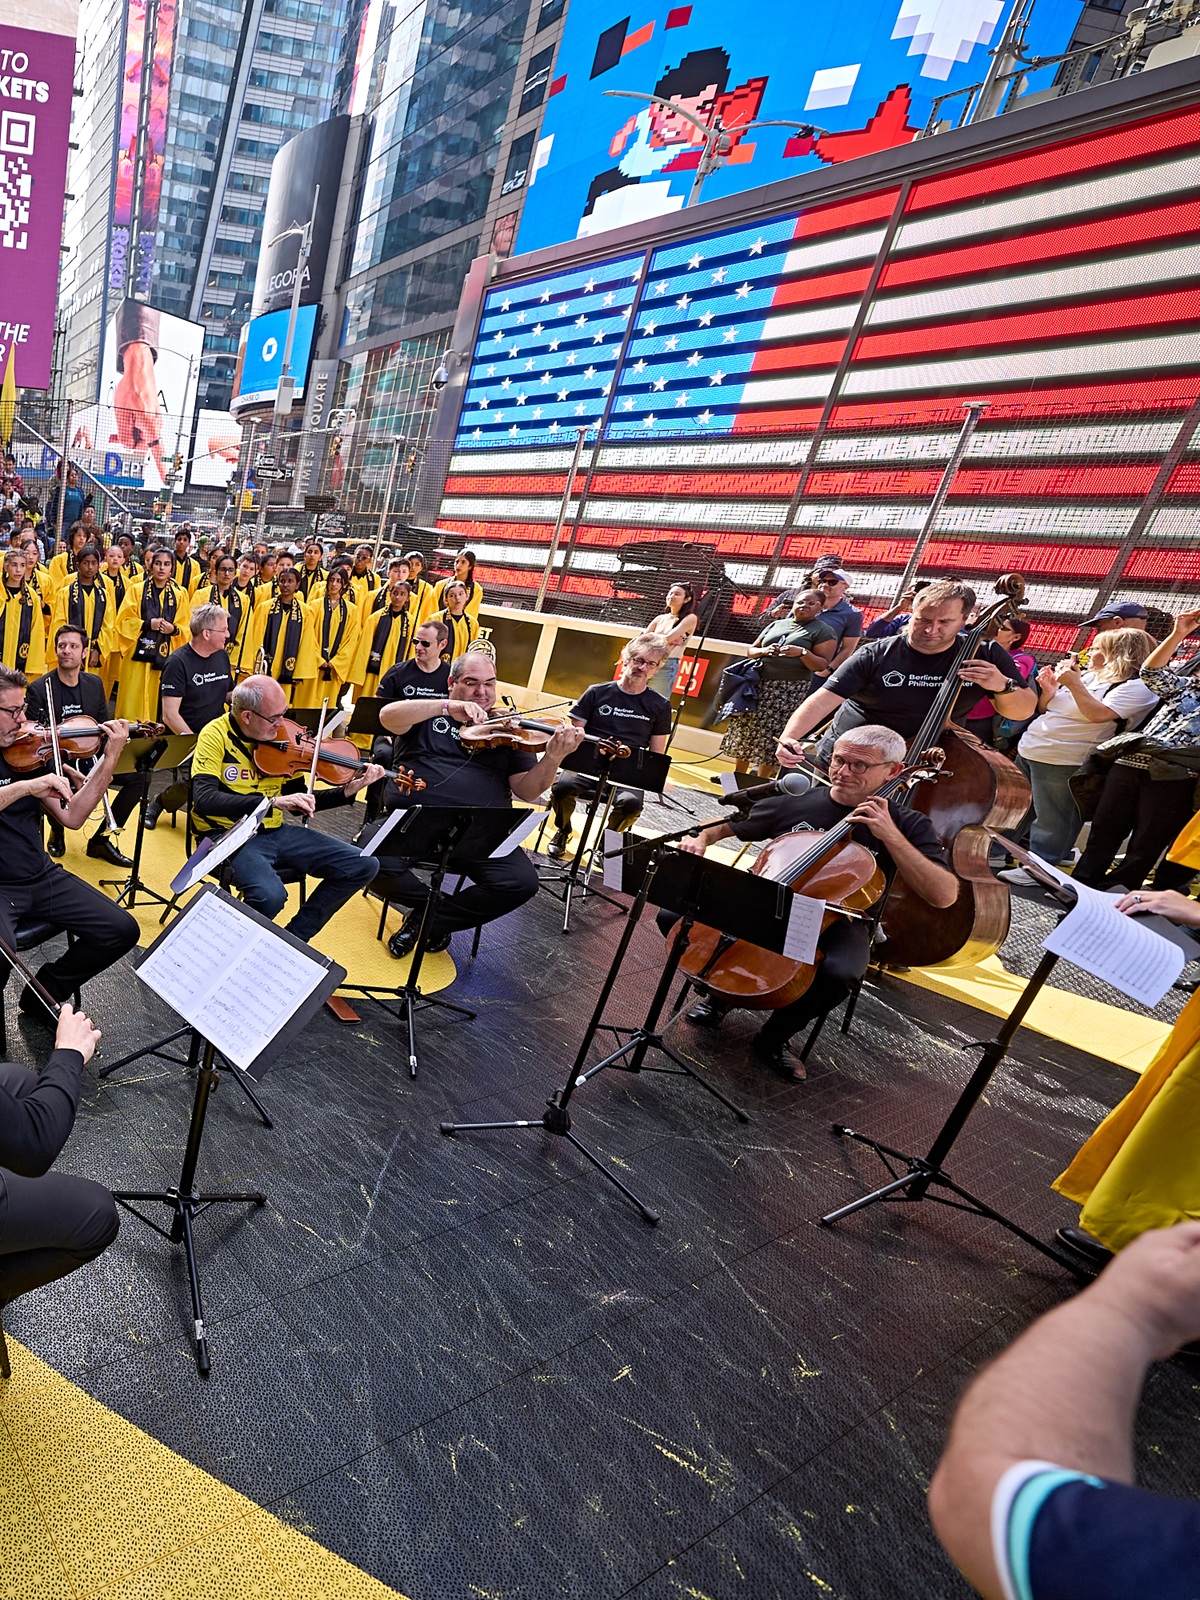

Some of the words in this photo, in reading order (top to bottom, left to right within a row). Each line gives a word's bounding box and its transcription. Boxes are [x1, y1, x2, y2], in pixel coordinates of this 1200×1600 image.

[1, 49, 29, 73] TO
[111, 228, 130, 289] ROKU
[300, 450, 315, 493] TIMES
[908, 673, 943, 681] Berliner
[613, 706, 635, 714] Berliner
